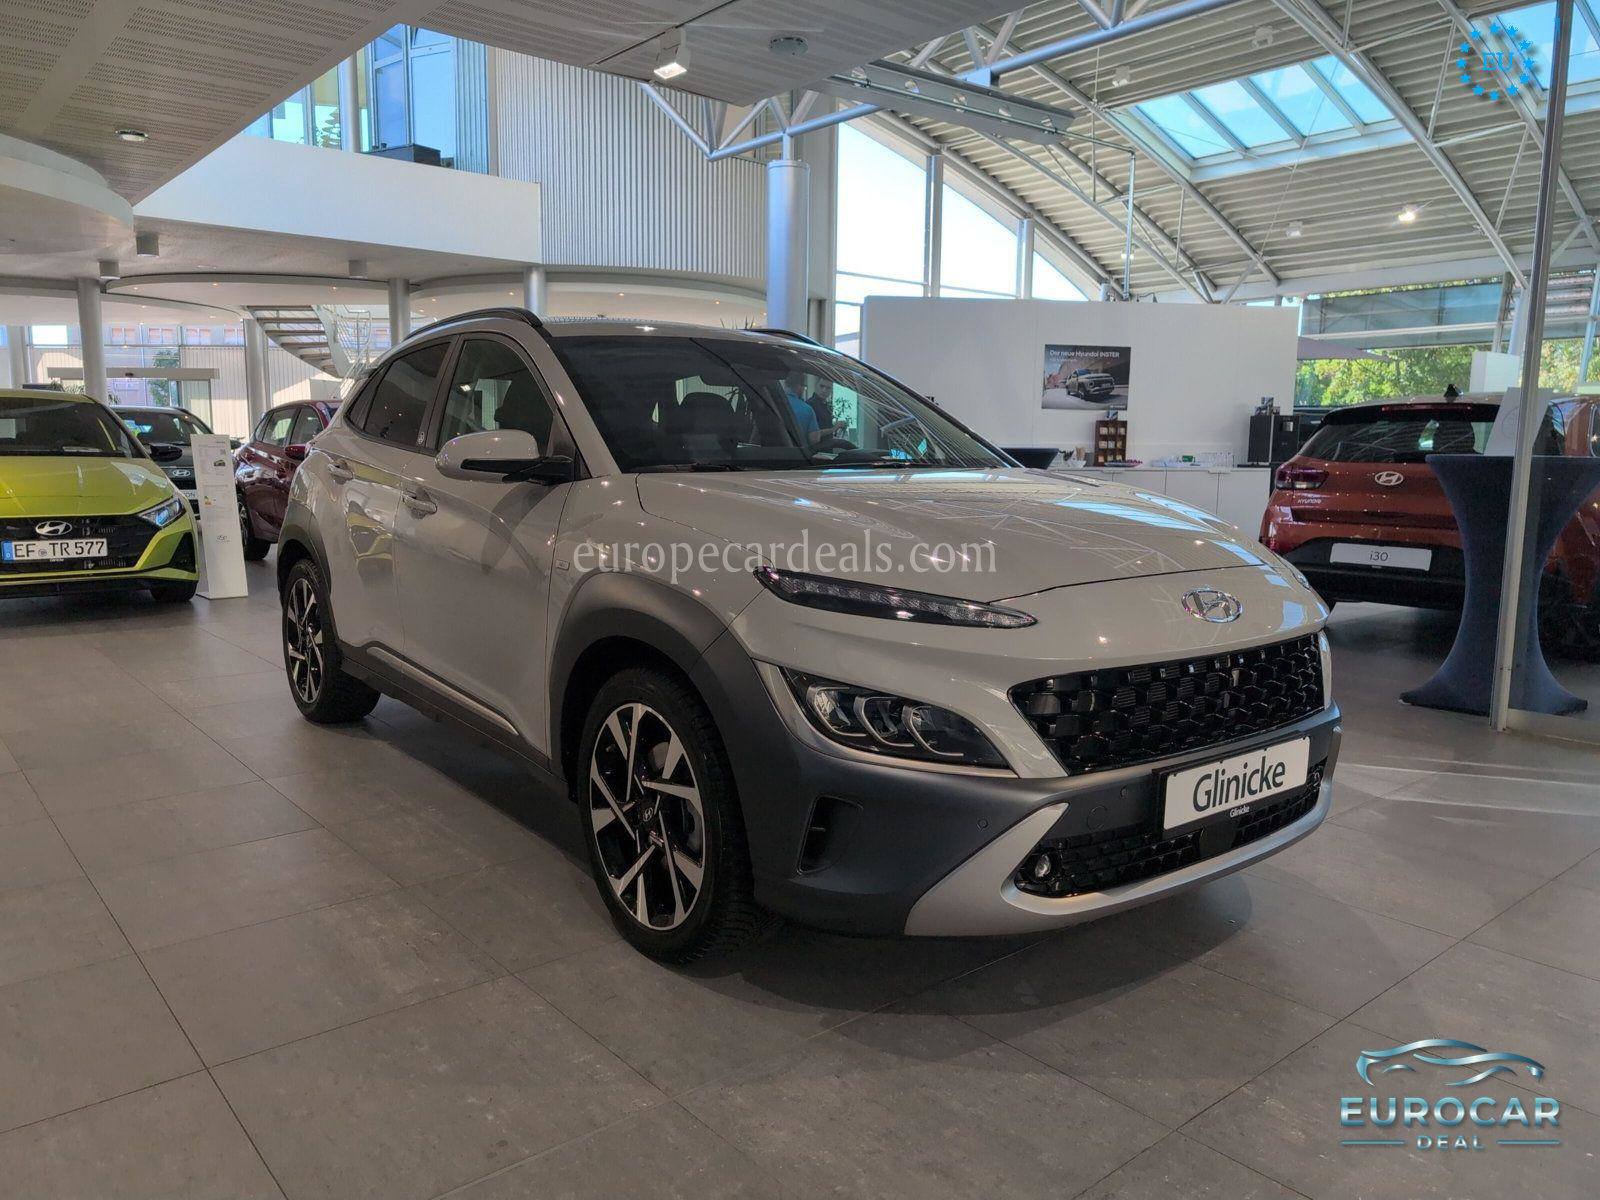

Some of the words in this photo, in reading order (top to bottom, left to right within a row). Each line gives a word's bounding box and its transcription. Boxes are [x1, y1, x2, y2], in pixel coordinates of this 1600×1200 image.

[14, 543, 36, 558] EF
[49, 542, 71, 557] TR
[74, 541, 105, 555] 577
[1369, 551, 1388, 561] i30
[1193, 756, 1286, 812] Glinicke
[1230, 805, 1250, 818] Glinicke
